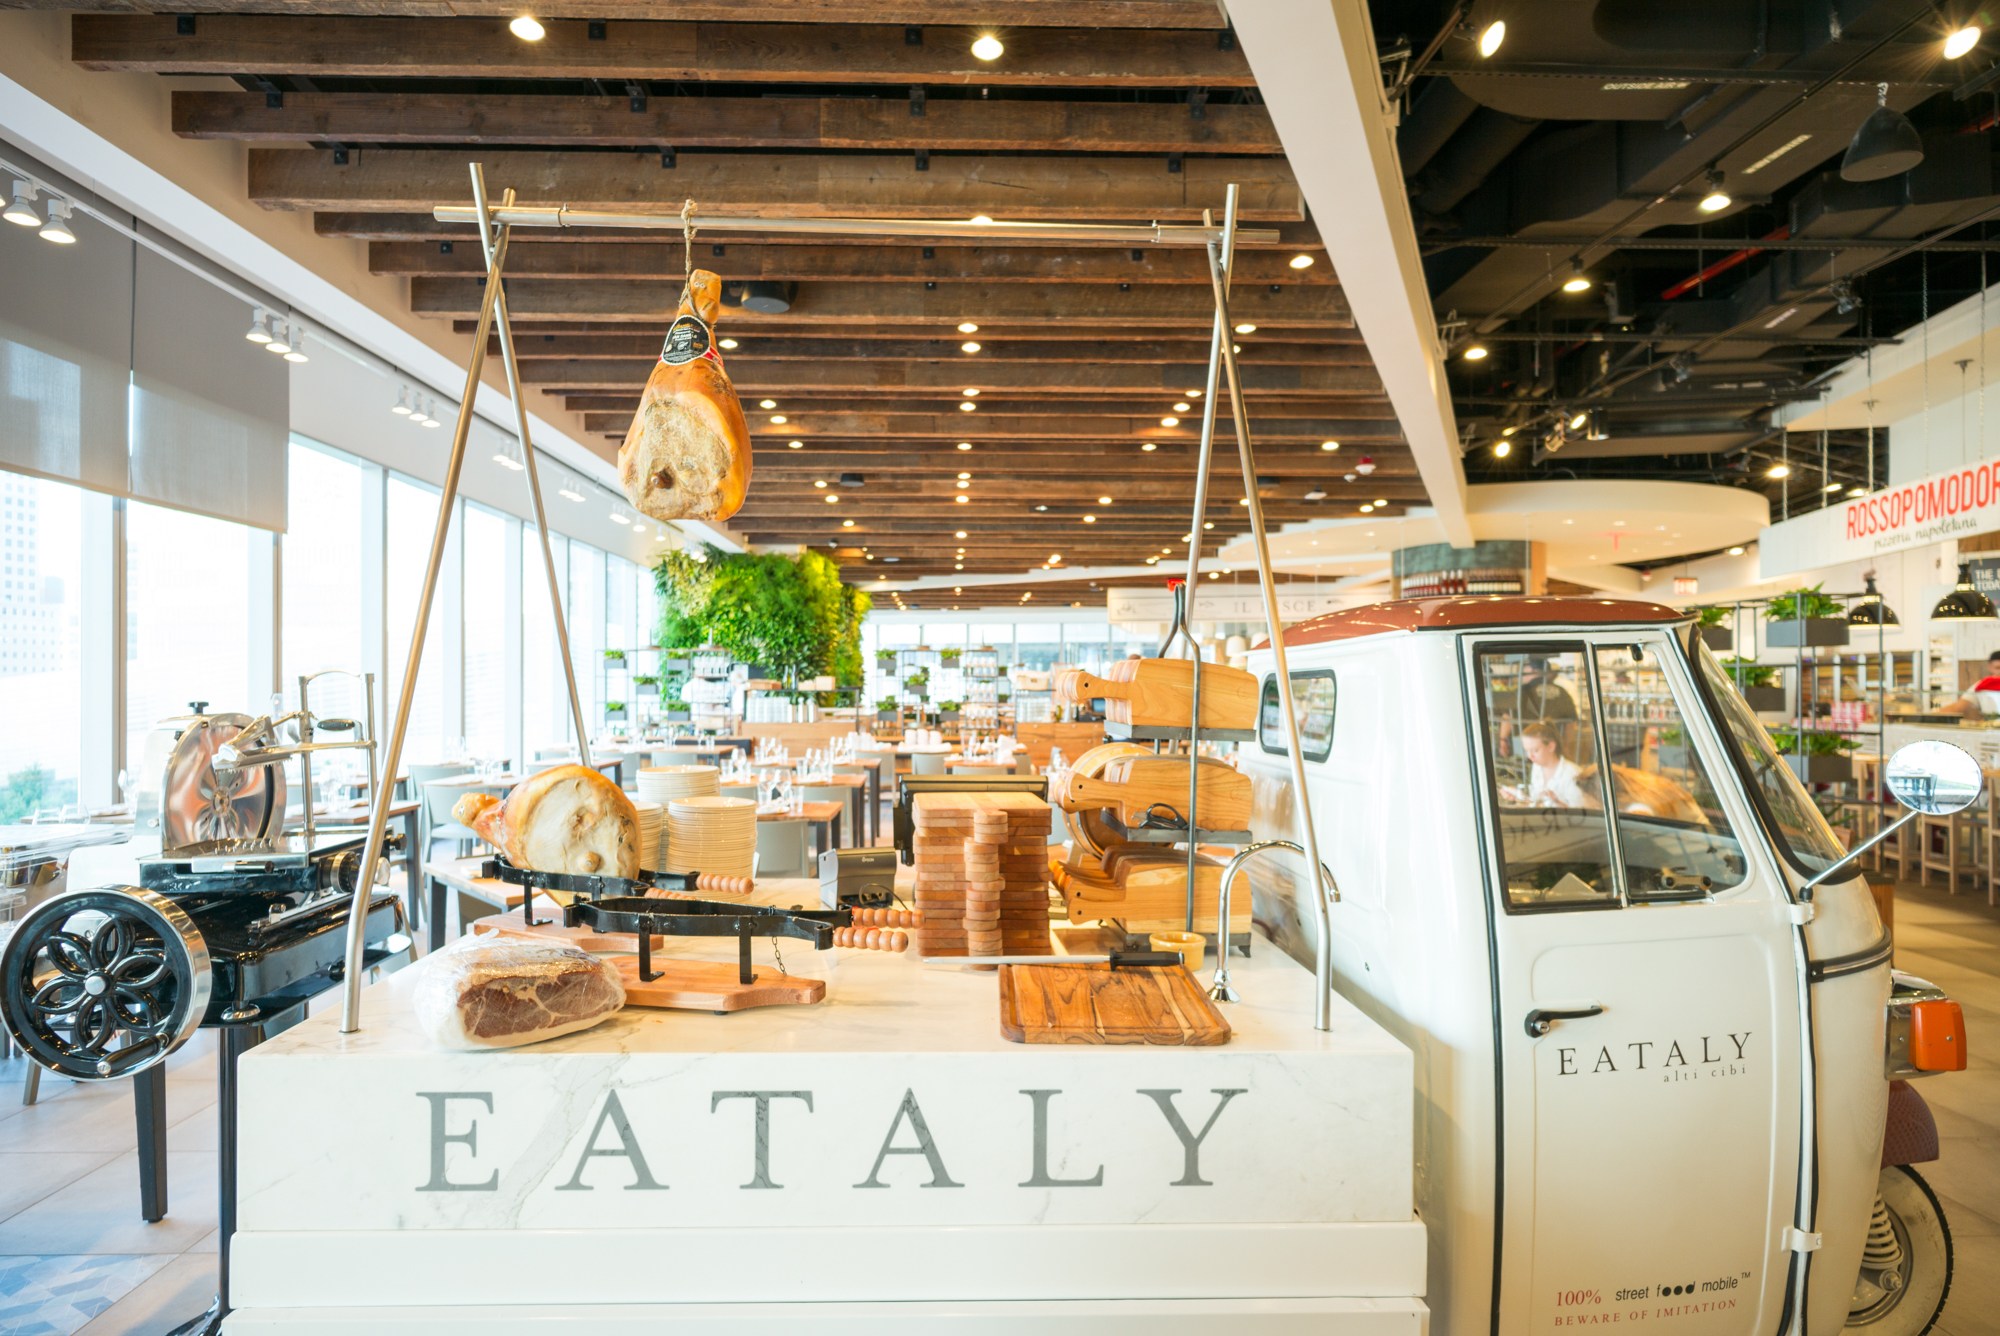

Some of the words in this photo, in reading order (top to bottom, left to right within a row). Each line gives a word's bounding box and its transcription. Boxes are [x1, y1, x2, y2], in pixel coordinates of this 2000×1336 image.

[1915, 517, 1977, 543] napoletana
[1556, 1032, 1753, 1076] EATALY
[1663, 1070, 1699, 1083] alti
[1711, 1064, 1747, 1078] cibi
[415, 1087, 1249, 1192] EATALY
[1556, 1289, 1602, 1307] 100%
[1615, 1286, 1650, 1302] street
[1554, 1312, 1621, 1327] BEWARE
[1629, 1310, 1649, 1321] OF
[1656, 1299, 1738, 1319] IMITATION
